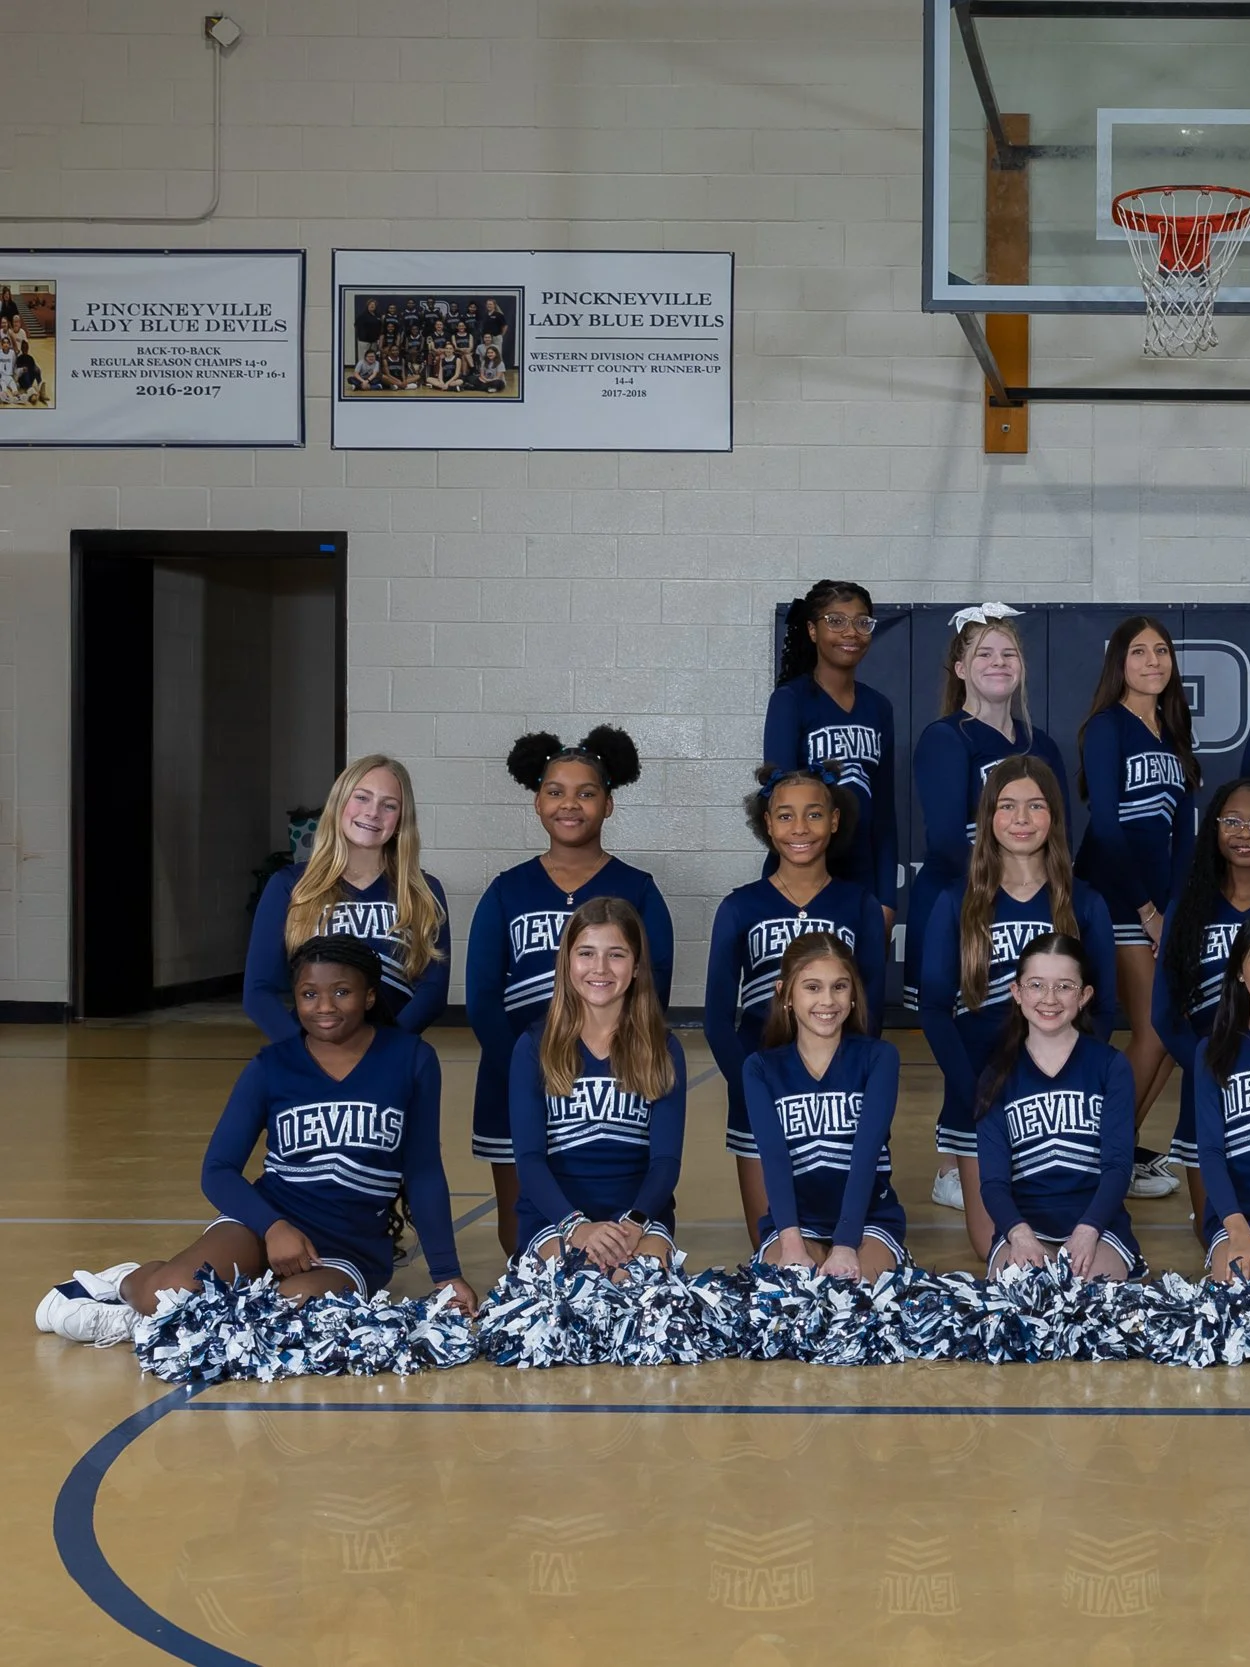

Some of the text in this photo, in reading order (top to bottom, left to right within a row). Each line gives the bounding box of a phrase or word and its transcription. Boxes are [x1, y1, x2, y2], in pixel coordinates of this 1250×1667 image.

[542, 292, 712, 306] PINCKNEYVILLE
[86, 303, 272, 316] PINCKNEYVILLE
[71, 319, 287, 332] LADY BLUE DEVILS
[528, 313, 724, 327] LADY BLUE DEVILS
[137, 347, 221, 355] BACK-TO-BACK
[530, 352, 719, 361] WESTERN DIVISION CHAMPIONS
[90, 358, 145, 366] REGULAR
[146, 358, 192, 366] SEASON
[194, 358, 242, 367] CHAMPS
[71, 370, 286, 378] & WESTERN DIVISION RUNNER-UP 16-1
[528, 364, 721, 373] GWINNETT COUNTY RUNNER-UP
[615, 377, 634, 385] 14-4
[136, 383, 221, 398] 2016-2017
[601, 389, 647, 397] 2017-2018
[1125, 752, 1186, 793] DEVI
[276, 1101, 404, 1157] DEVILS
